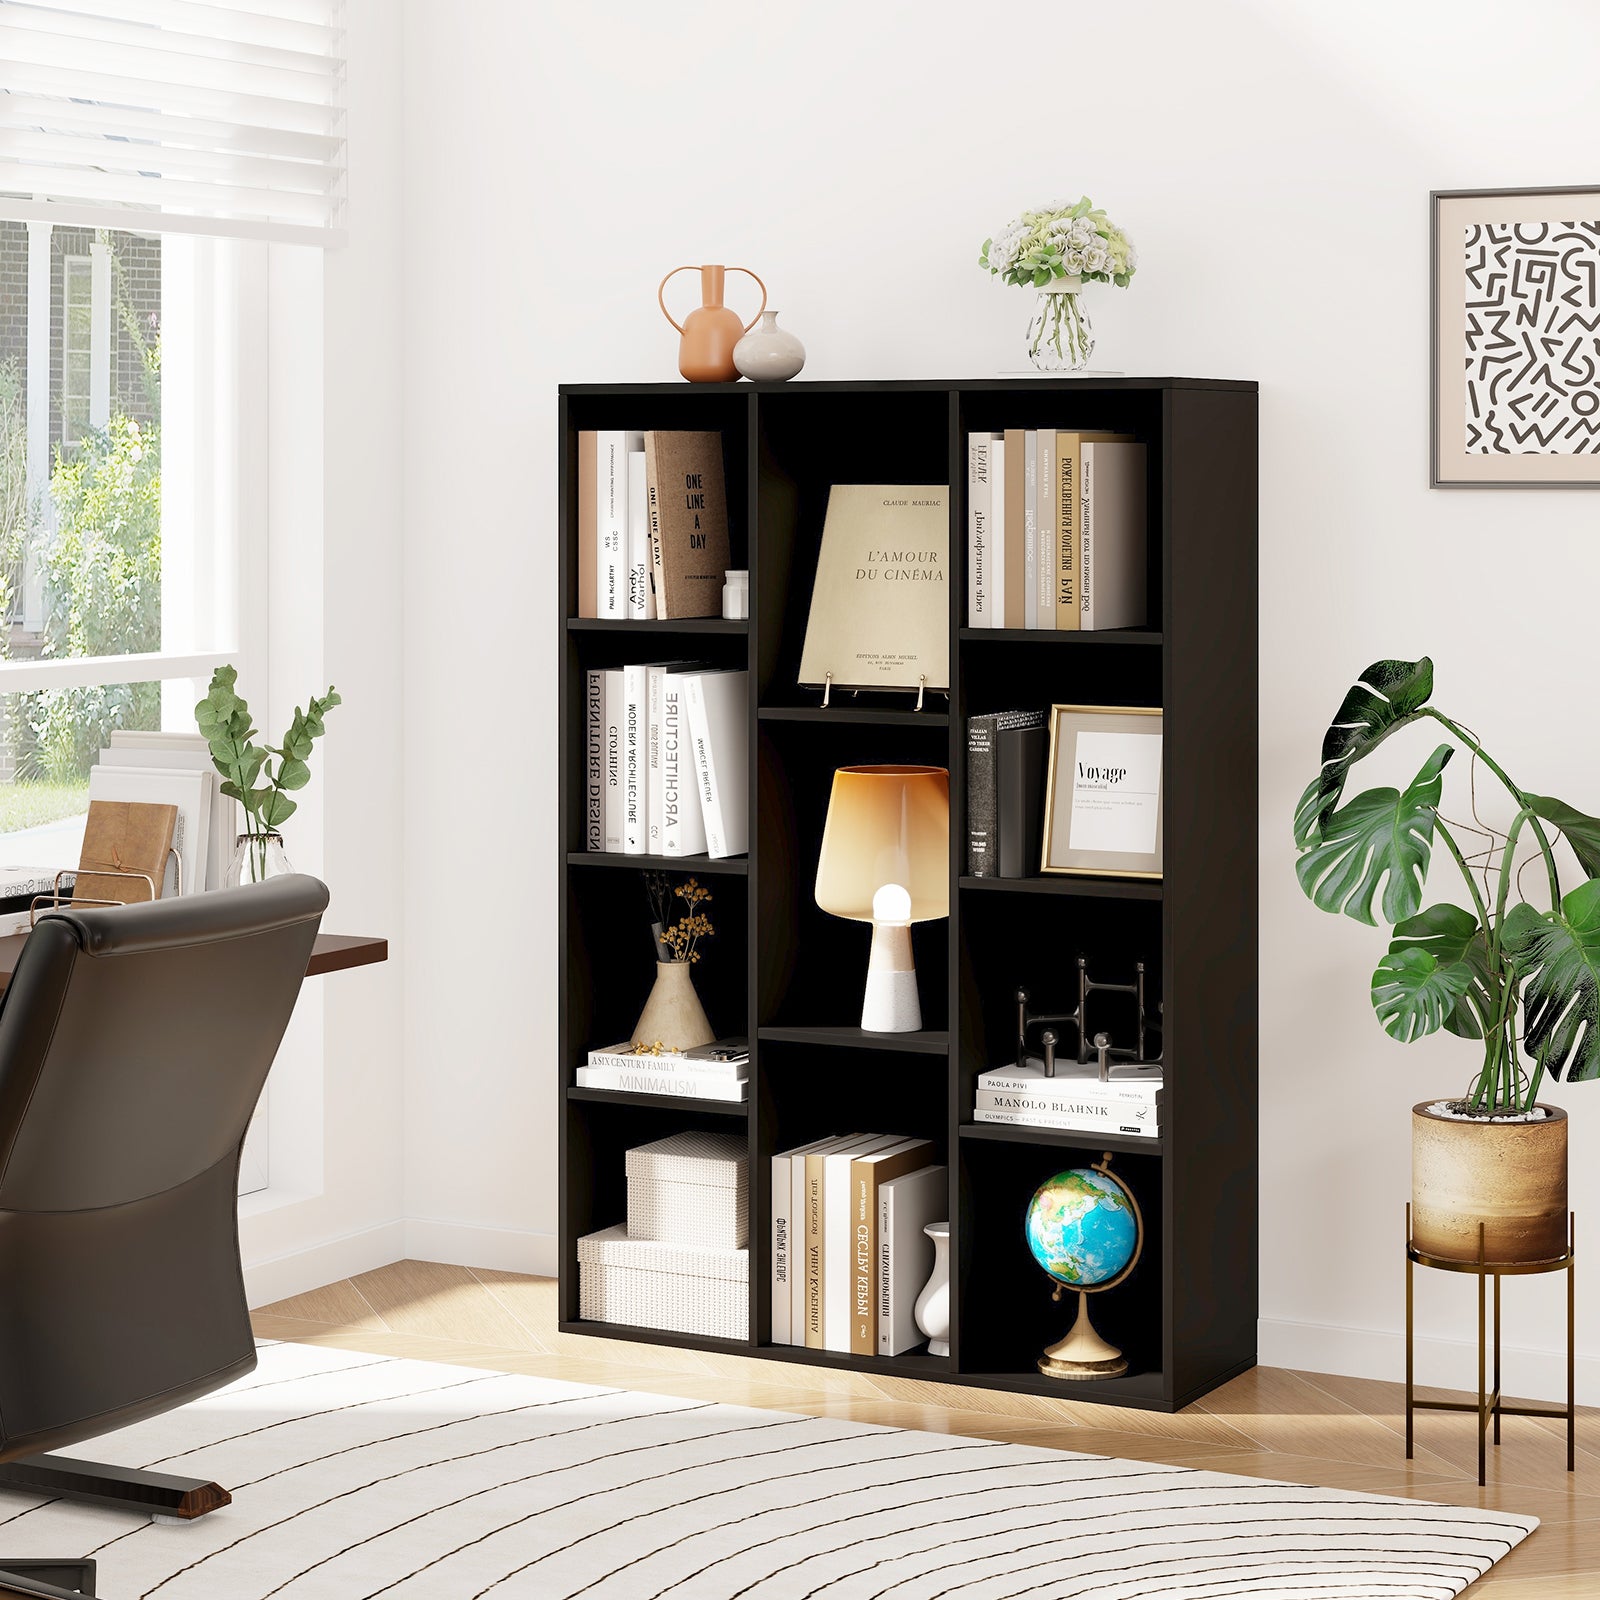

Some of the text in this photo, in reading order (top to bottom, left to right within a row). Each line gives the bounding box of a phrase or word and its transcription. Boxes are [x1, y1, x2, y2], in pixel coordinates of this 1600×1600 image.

[686, 474, 702, 489] ONE
[686, 494, 705, 510] LINE
[694, 514, 700, 529] A
[605, 536, 610, 548] WS
[690, 535, 706, 549] DAY
[868, 551, 937, 562] L'AMOUR
[855, 567, 944, 581] DU CINÉMA
[629, 569, 639, 604] Andy
[1079, 762, 1126, 784] Voyage
[592, 1057, 676, 1072] A SIX CENTURY FAMILY
[619, 1075, 697, 1095] MINIMALISM
[994, 1097, 1108, 1116] MANOLO BLAHNIK
